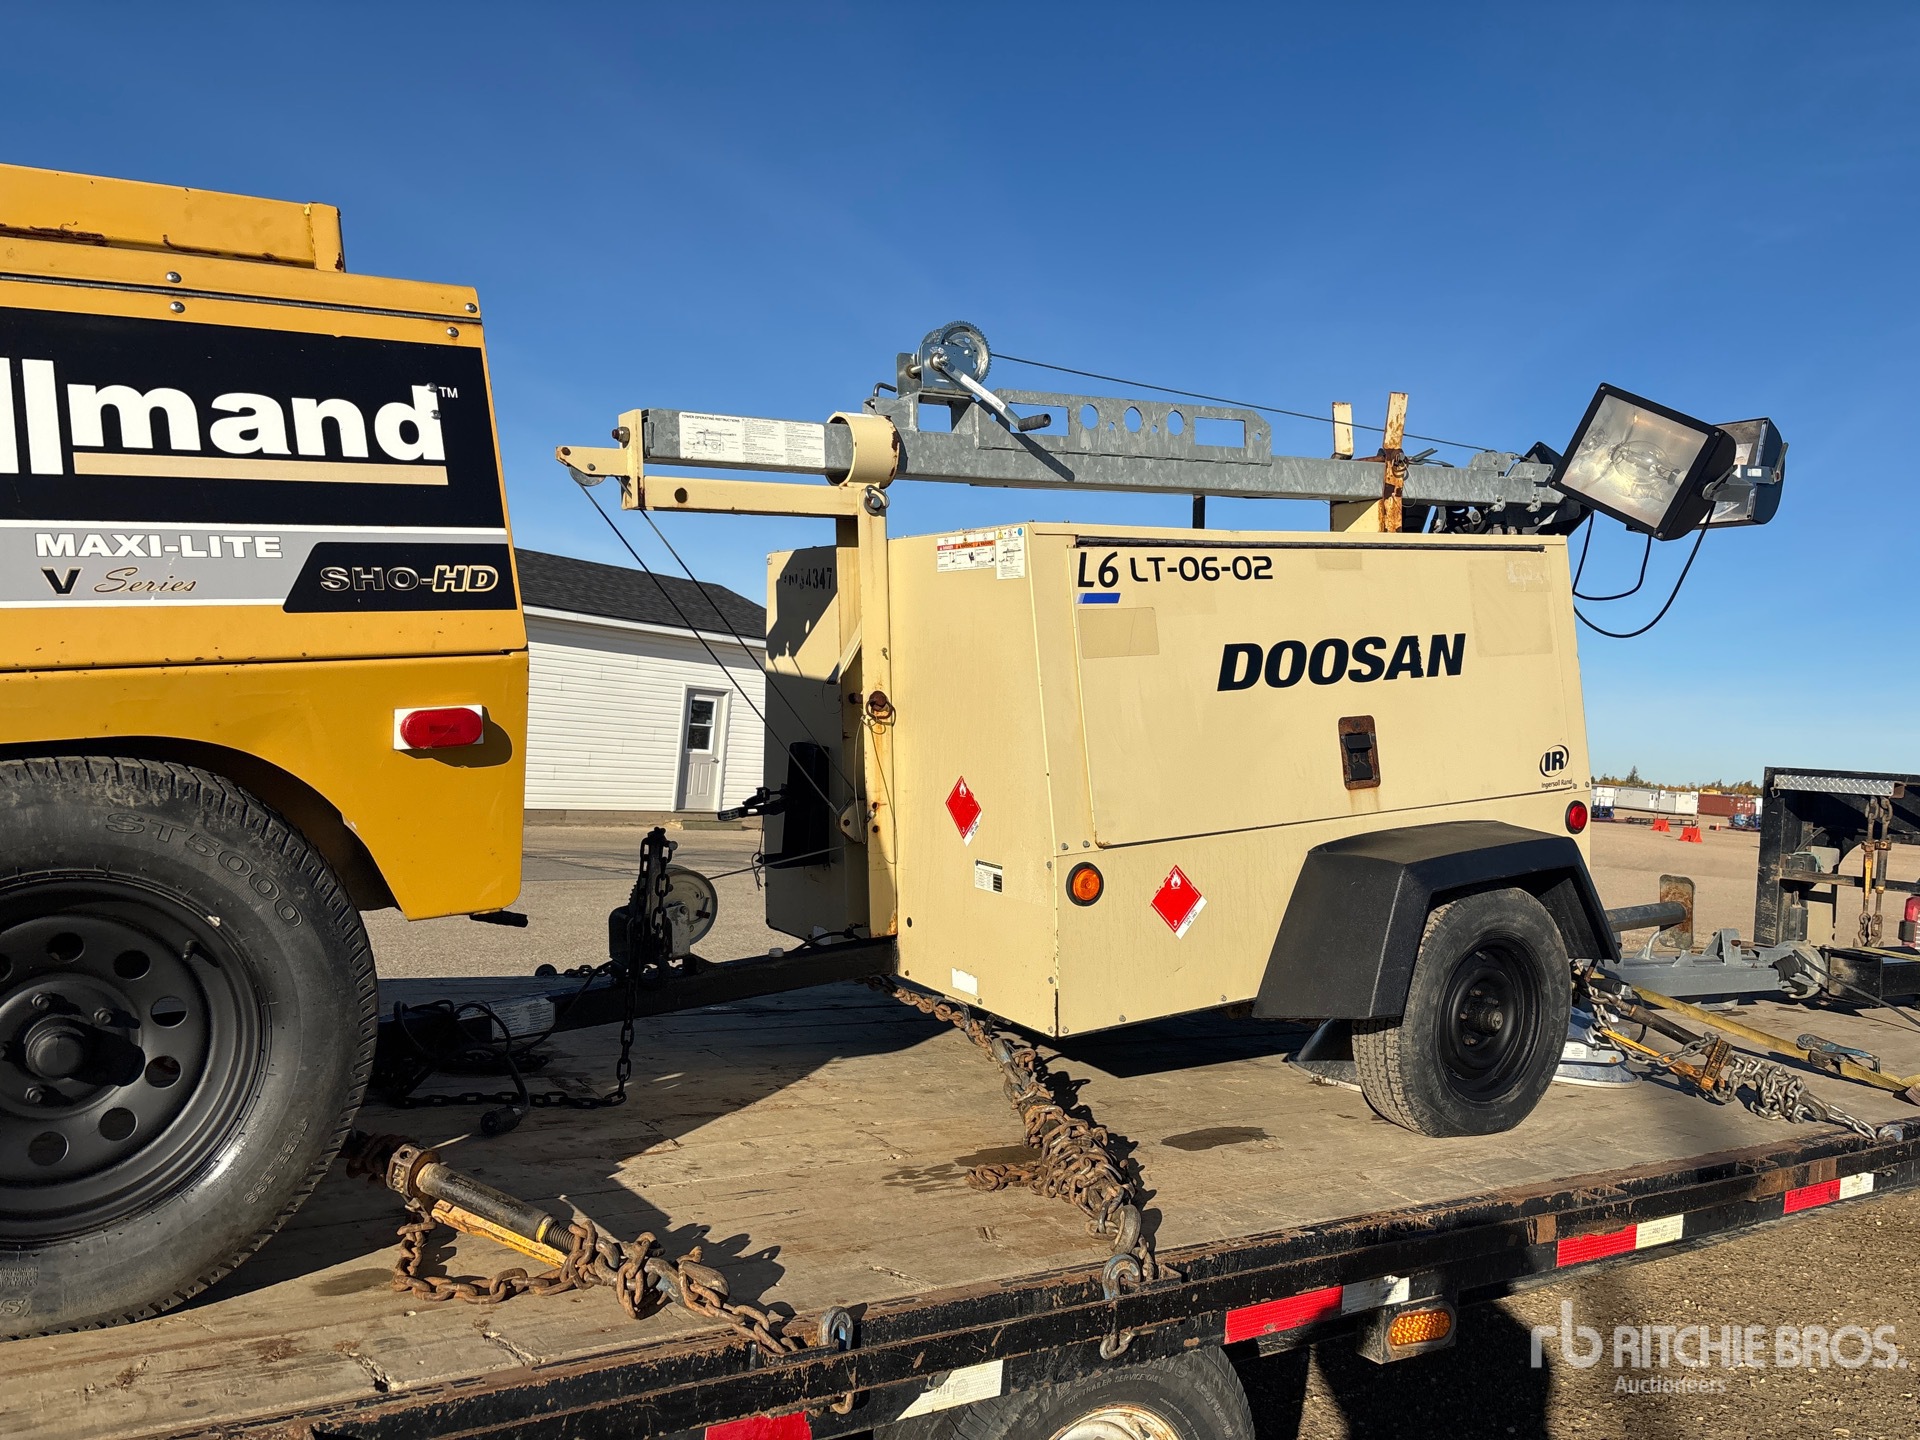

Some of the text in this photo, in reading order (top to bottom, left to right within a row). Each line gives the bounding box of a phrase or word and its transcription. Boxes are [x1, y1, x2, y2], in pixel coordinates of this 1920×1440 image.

[36, 533, 283, 559] MAXI-LITE
[41, 567, 198, 595] V Series
[320, 565, 499, 593] SHO-HD
[1077, 551, 1273, 588] L6 LT-06-02
[1217, 633, 1466, 692] DOOSAN
[1545, 751, 1564, 771] IR
[105, 812, 303, 928] ST5000
[1063, 1393, 1080, 1407] FOR
[1082, 1378, 1112, 1396] TRAILER
[1115, 1373, 1145, 1384] SERVICE
